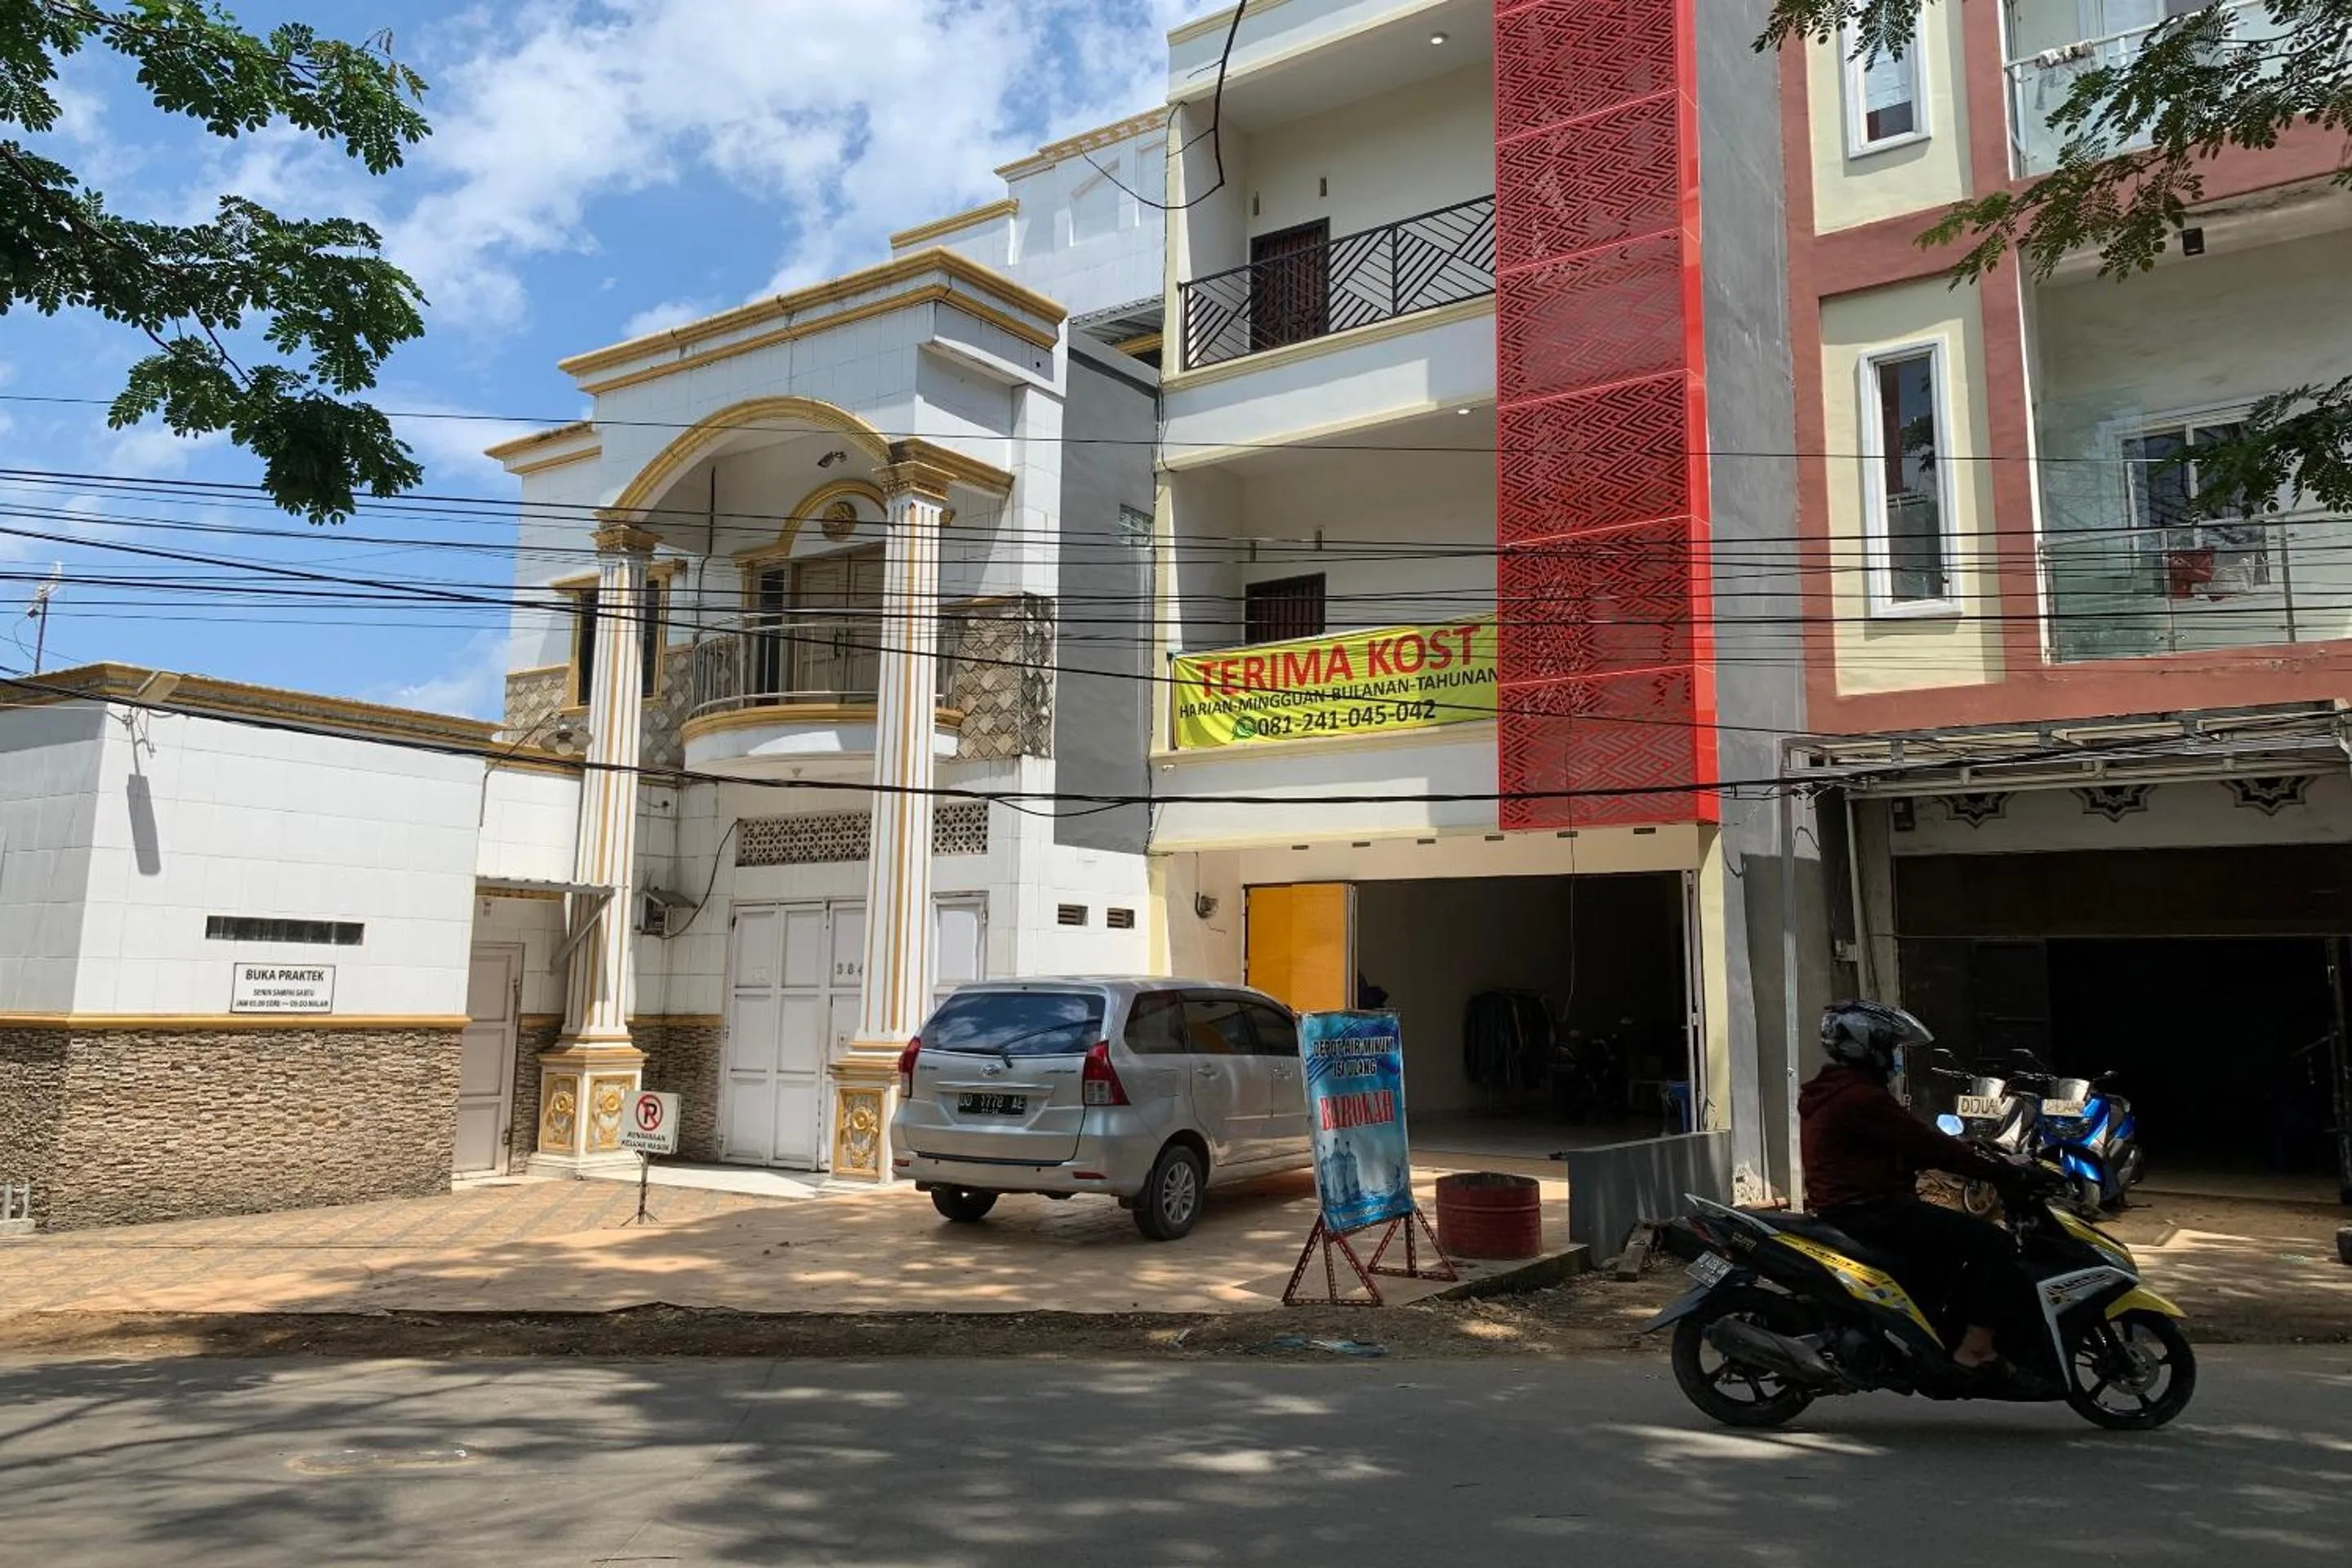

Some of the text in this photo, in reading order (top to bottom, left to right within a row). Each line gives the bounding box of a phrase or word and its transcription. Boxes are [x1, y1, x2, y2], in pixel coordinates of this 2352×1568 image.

[1196, 626, 1480, 697] TERIMA KOST
[1258, 699, 1436, 737] 081-241-045-042
[246, 969, 324, 982] BUKA PRAKTEK
[1321, 1091, 1393, 1130] BAROKAH
